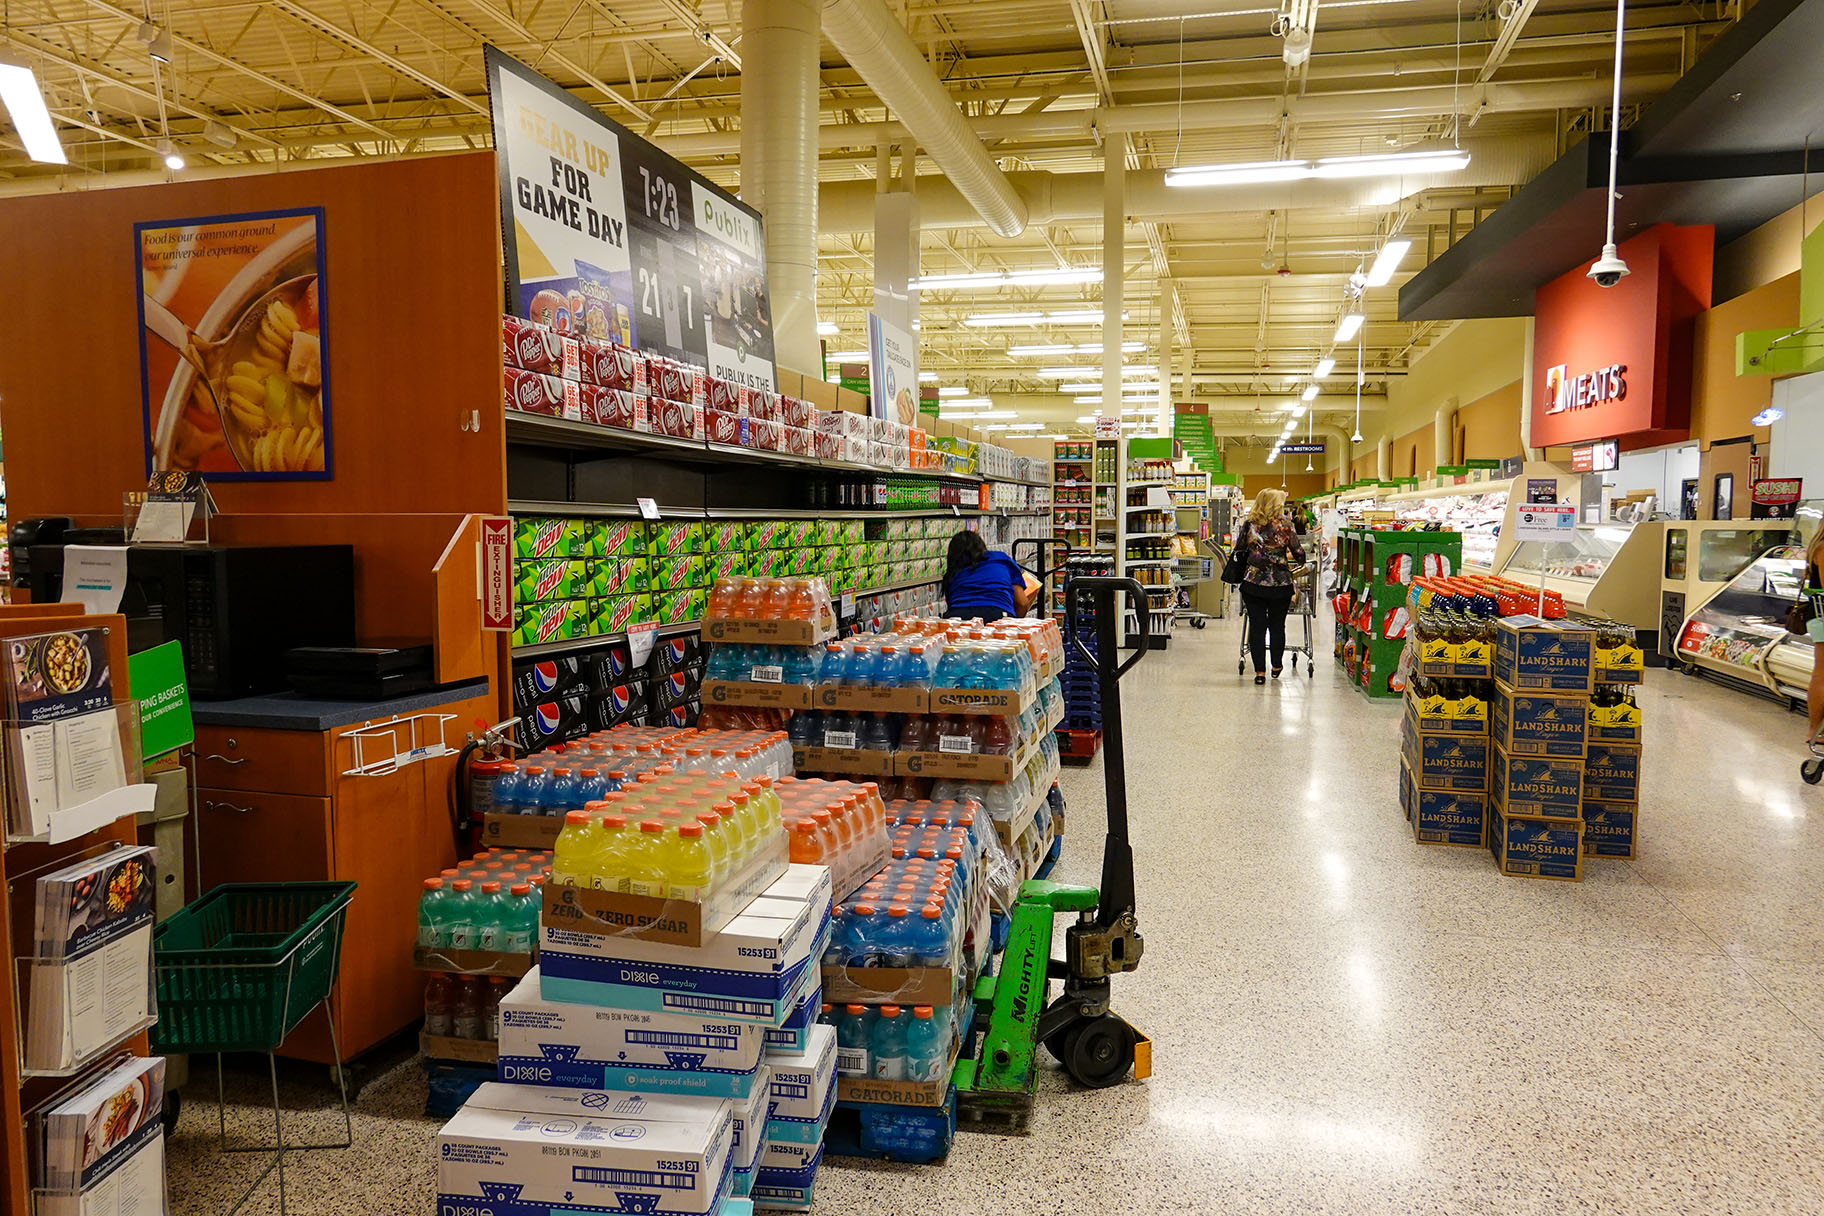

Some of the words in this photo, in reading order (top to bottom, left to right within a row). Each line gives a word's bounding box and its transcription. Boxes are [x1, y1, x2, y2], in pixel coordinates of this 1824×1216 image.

[519, 105, 579, 164] GEAR
[584, 140, 610, 178] UP
[550, 156, 592, 203] FOR
[639, 166, 680, 231] 7:23
[517, 176, 582, 232] GAME
[586, 207, 623, 249] DAY
[704, 200, 750, 247] Publix
[144, 233, 169, 245] Food
[169, 234, 176, 243] is
[178, 232, 193, 243] our
[195, 228, 239, 241] common
[239, 223, 276, 241] ground
[163, 246, 206, 260] universal
[638, 267, 661, 318] 21
[683, 284, 694, 329] 7
[716, 364, 746, 385] PUBLIX
[747, 373, 754, 387] IS
[756, 376, 770, 392] THE
[860, 366, 868, 377] 2
[1563, 363, 1622, 409] MEATS
[1755, 482, 1800, 495] SUSHI
[488, 534, 506, 545] FIRE
[493, 545, 502, 619] EXTINGUISHER
[710, 622, 724, 638] G
[1520, 655, 1587, 667] LANDSHARK
[604, 657, 614, 682] pepsi
[525, 672, 538, 699] pepsi
[140, 695, 158, 711] PING
[157, 683, 185, 704] BASKETS
[712, 685, 726, 702] G
[822, 690, 837, 706] G
[939, 694, 1008, 707] GATORADE
[52, 703, 66, 711] Garlic
[141, 713, 152, 723] OUR
[152, 699, 183, 718] CONVENIENCE
[606, 696, 616, 719] pepsi
[32, 712, 51, 721] Chicken
[527, 714, 540, 742] pepsi
[1515, 721, 1582, 733] LANDSHARK
[908, 756, 922, 772] G
[1424, 757, 1484, 769] LANDSHARK
[1584, 768, 1635, 779] NDSHARK
[1510, 782, 1577, 796] LANDSHARK
[1421, 812, 1480, 825] LANDSHARK
[1587, 825, 1631, 836] DSHARK
[1509, 841, 1575, 856] LANDSHARK
[562, 889, 574, 905] G
[551, 903, 583, 920] ZERO
[595, 910, 634, 927] ZERO
[637, 915, 689, 934] SUGAR
[547, 927, 554, 939] 9
[738, 948, 763, 958] 15253
[764, 949, 776, 959] 91
[662, 979, 698, 990] everyday
[1011, 948, 1034, 1023] MIGHTY
[503, 1011, 511, 1022] 9
[702, 1024, 727, 1034] 15253
[728, 1025, 740, 1035] 91
[556, 1074, 597, 1086] everyday
[640, 1076, 658, 1084] soak
[660, 1077, 681, 1086] proof
[682, 1078, 706, 1087] shield
[774, 1073, 798, 1083] 15253
[799, 1074, 810, 1084] 91
[849, 1087, 937, 1105] GATORADE
[442, 1143, 450, 1156] 9
[770, 1145, 793, 1154] 15253
[657, 1160, 684, 1170] 15253
[685, 1161, 698, 1172] 91
